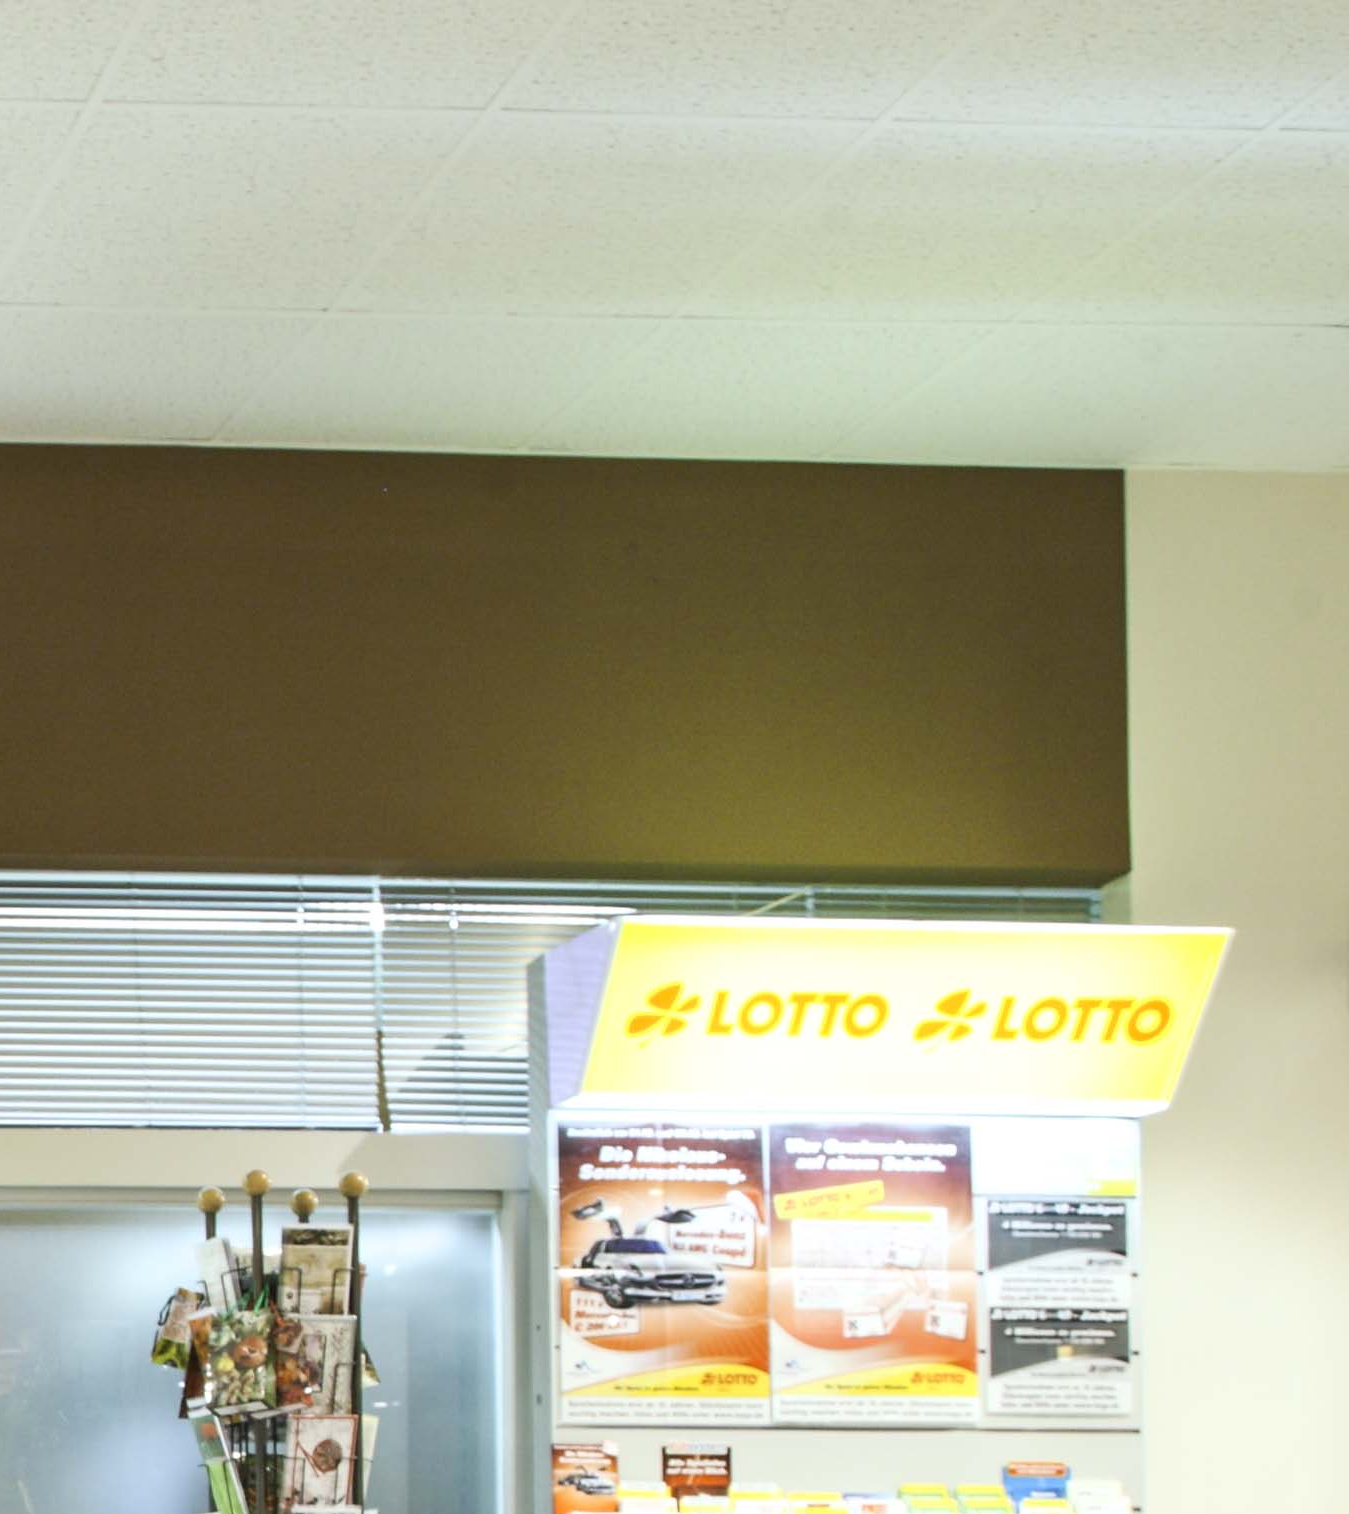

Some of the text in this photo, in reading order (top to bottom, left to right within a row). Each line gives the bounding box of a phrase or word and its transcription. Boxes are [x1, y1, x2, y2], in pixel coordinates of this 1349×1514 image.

[705, 991, 1171, 1045] LOTTO LOTTO
[716, 1372, 759, 1385] LOTTO
